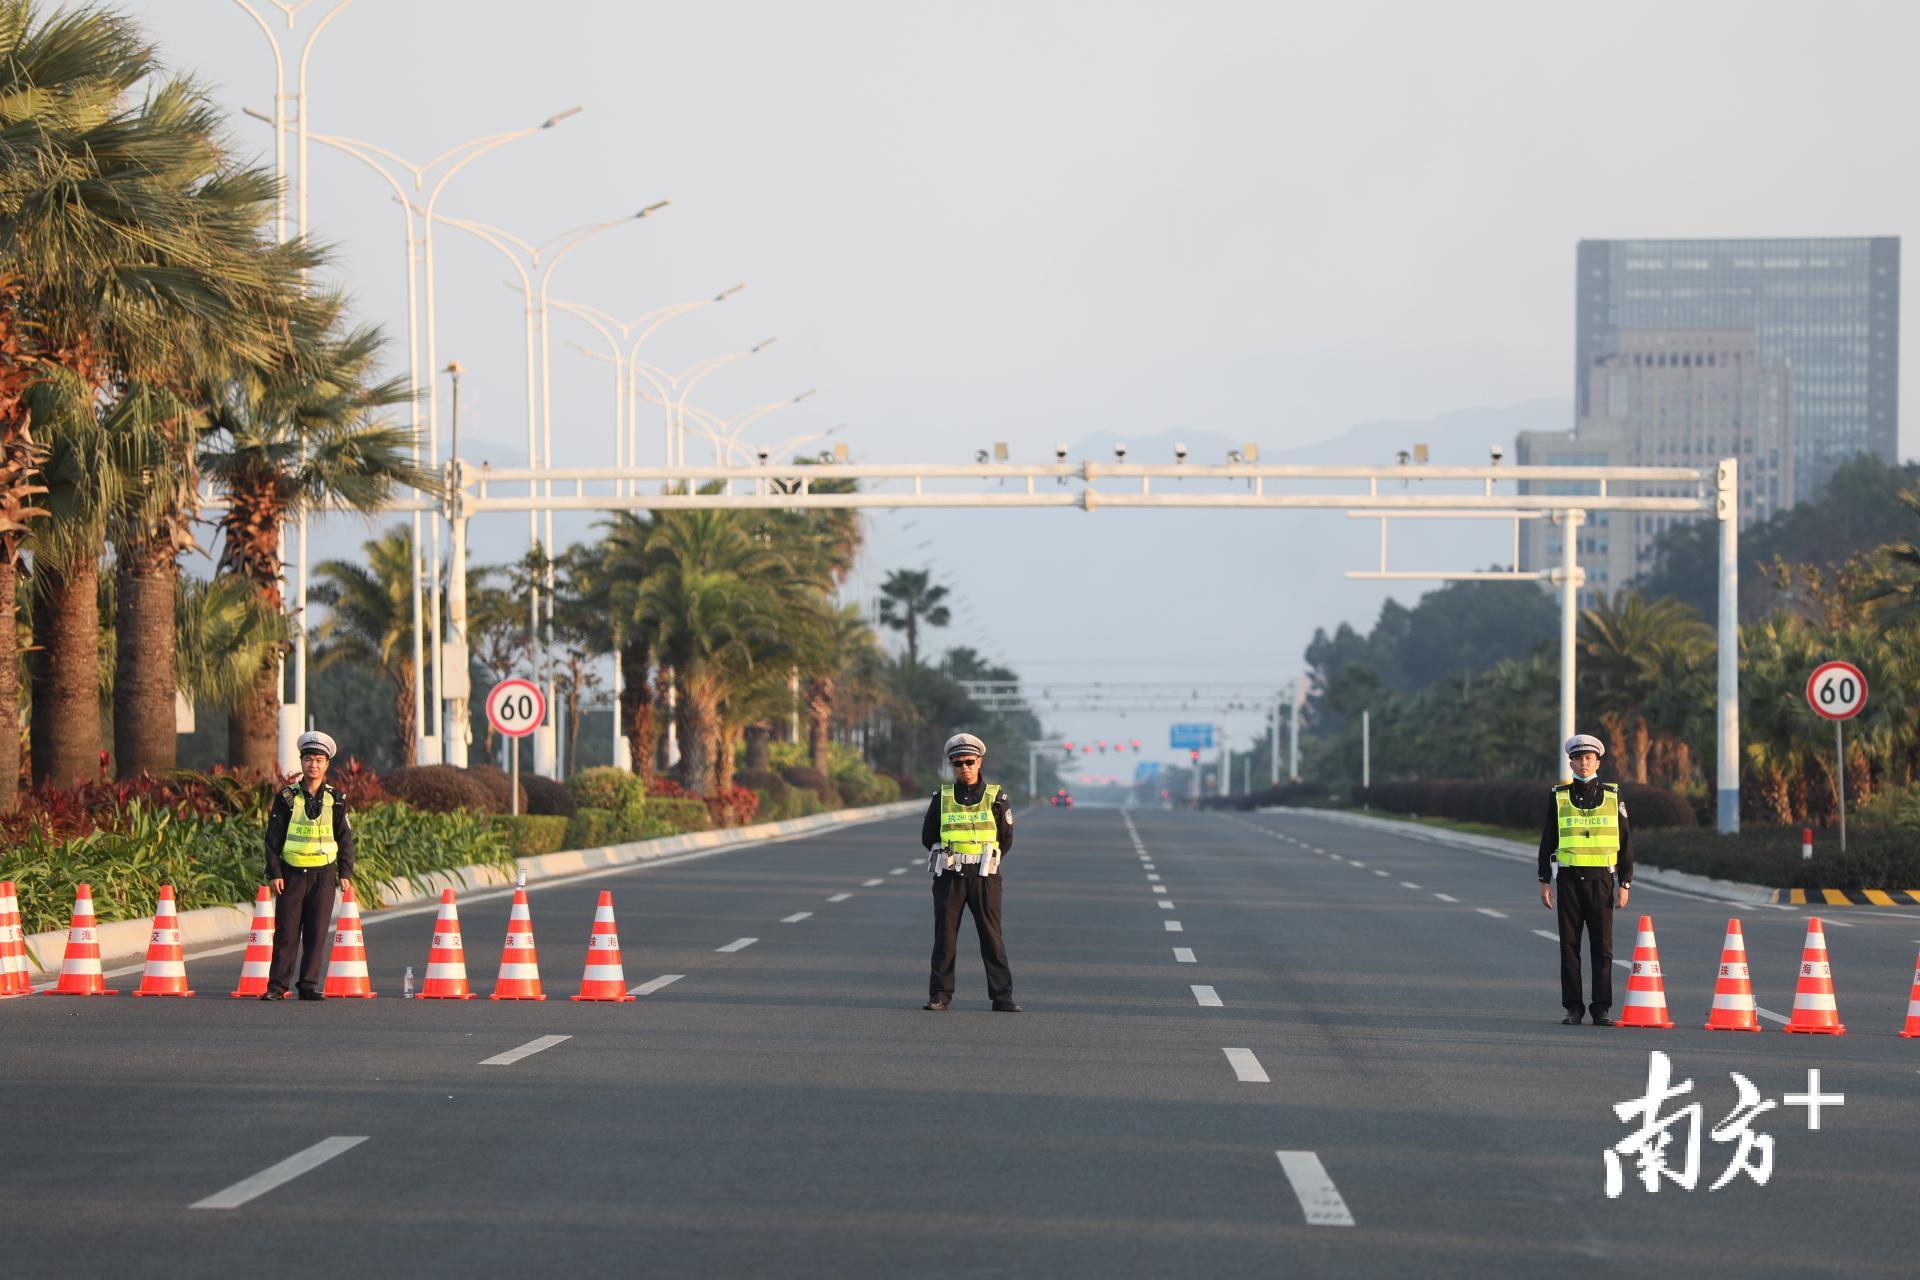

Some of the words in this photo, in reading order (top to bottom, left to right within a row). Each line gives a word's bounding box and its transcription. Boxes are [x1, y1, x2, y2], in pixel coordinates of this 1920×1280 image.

[1820, 677, 1855, 705] 60
[500, 694, 533, 720] 60
[1574, 817, 1601, 825] POLICE
